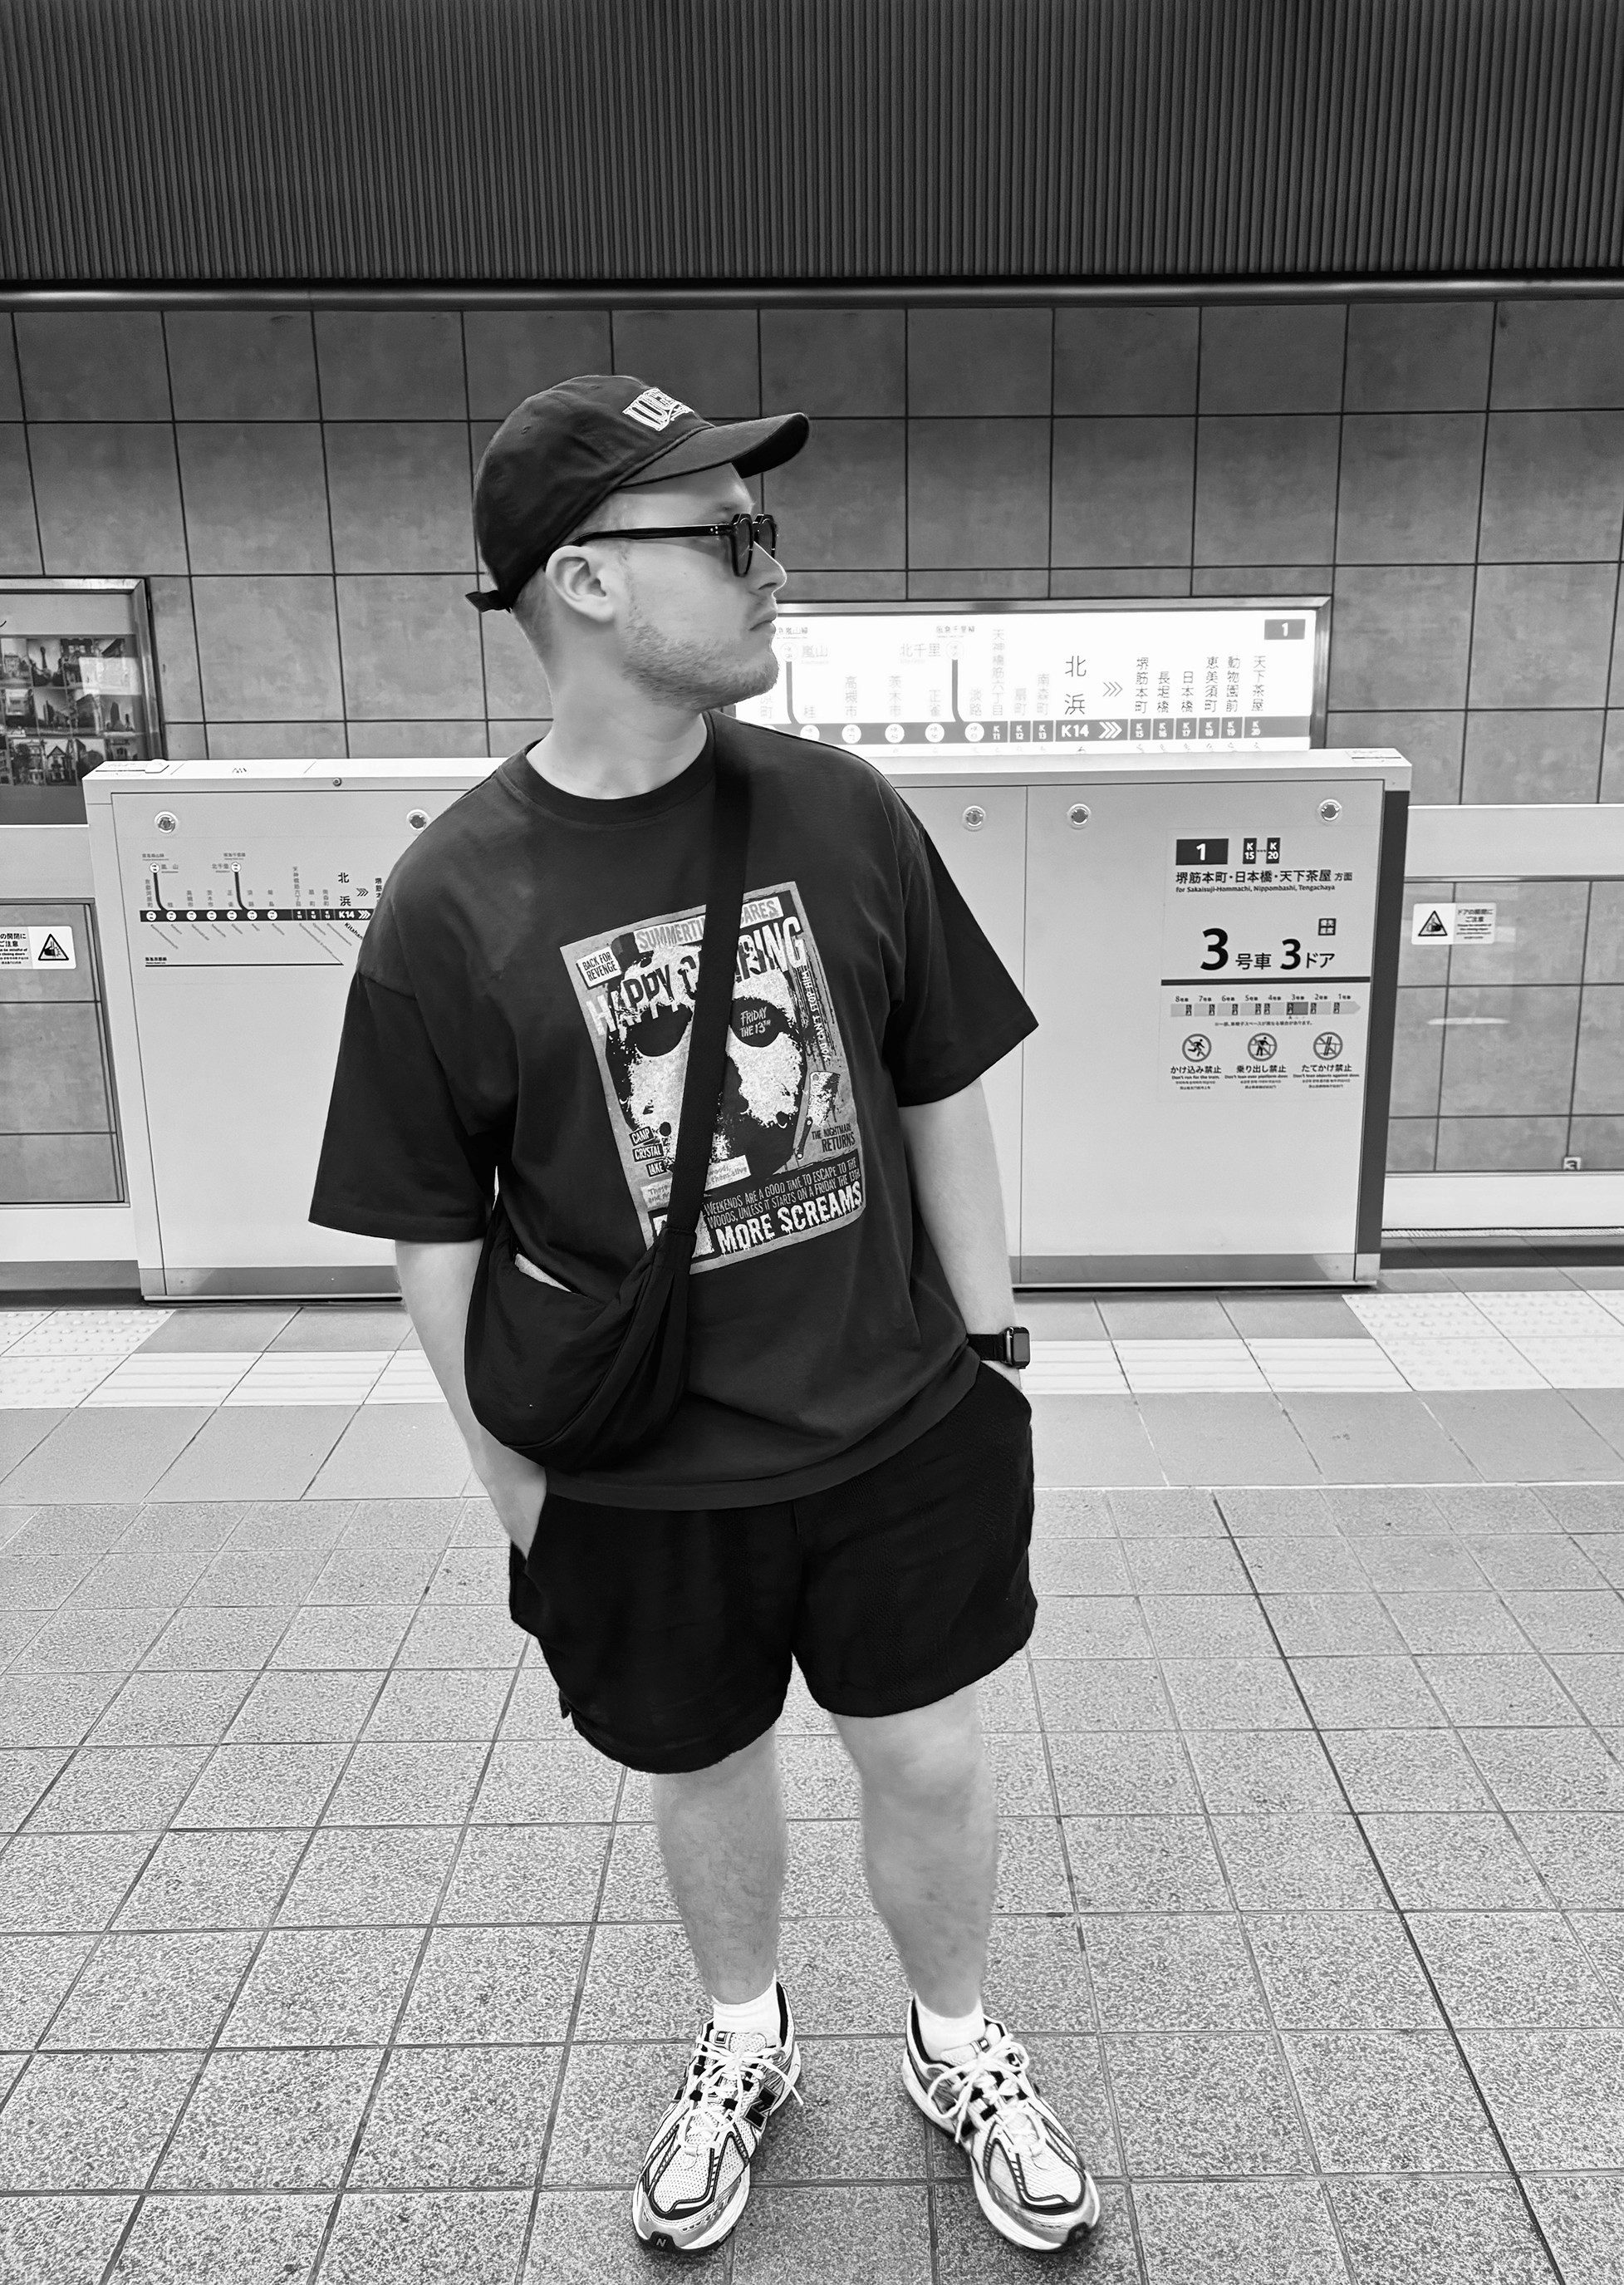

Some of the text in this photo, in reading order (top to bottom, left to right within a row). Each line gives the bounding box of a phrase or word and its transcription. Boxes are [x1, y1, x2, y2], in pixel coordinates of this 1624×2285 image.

[1281, 622, 1289, 637] 1
[900, 642, 941, 657] 北千里
[1064, 655, 1087, 715] 北浜
[1135, 656, 1149, 714] 堺筋本町
[1157, 671, 1170, 713] 長堀橋
[1181, 671, 1195, 713] 日本橋
[1205, 656, 1219, 712] 恵美須町
[1226, 655, 1240, 712] 動物園前
[1251, 655, 1266, 711] 天下茶屋
[844, 676, 858, 717] 高槻市
[889, 675, 902, 717] 茨木市
[969, 688, 982, 716] 淡路
[1037, 673, 1050, 716] 南森町
[803, 705, 817, 719] 桂
[1061, 724, 1090, 738] K14
[1196, 843, 1206, 861] 1
[1247, 843, 1254, 851] K
[1270, 842, 1278, 850] K
[1245, 852, 1255, 860] 15
[1268, 852, 1279, 860] 20
[1175, 869, 1353, 884] 堺筋本町・日本橋・天下茶屋 方面
[337, 872, 351, 907] 北浜
[338, 911, 355, 919] K14
[634, 916, 705, 950] SUMMERTI
[582, 951, 612, 971] BACK FOR
[586, 961, 618, 981] REVENGE
[801, 971, 812, 989] HIM
[586, 964, 679, 1037] HAPPY
[805, 991, 819, 1012] STOP
[740, 1007, 768, 1025] FRIDAY
[739, 1024, 754, 1038] THE
[819, 1042, 832, 1063] YOU
[1170, 1065, 1222, 1074] かけ込み禁止
[1236, 1064, 1287, 1074] 乗り出し禁止
[1302, 1064, 1352, 1073] たてかけ禁止
[631, 1128, 650, 1144] CAMP
[812, 1123, 851, 1140] THE NIGHTMARE
[822, 1132, 856, 1152] RETURNS
[634, 1146, 662, 1161] CRYSTAL
[648, 1163, 665, 1176] LAKE
[704, 1196, 743, 1216] WEEKENDS
[745, 1190, 758, 1203] ARE
[759, 1189, 764, 1198] A
[765, 1182, 786, 1197] GOOD
[802, 1175, 812, 1186] TO
[812, 1167, 837, 1182] ESCAPE
[837, 1164, 846, 1175] TO
[846, 1157, 857, 1169] THE
[707, 1212, 738, 1229] WOODS,
[738, 1201, 763, 1218] UNLESS
[772, 1193, 797, 1208] STARTS
[797, 1190, 808, 1201] ON
[808, 1188, 814, 1198] A
[814, 1181, 837, 1197] FRIDAY
[837, 1175, 849, 1187] THE
[715, 1213, 775, 1253] MORE
[777, 1181, 862, 1235] SCREAMS
[655, 2237, 668, 2247] N
